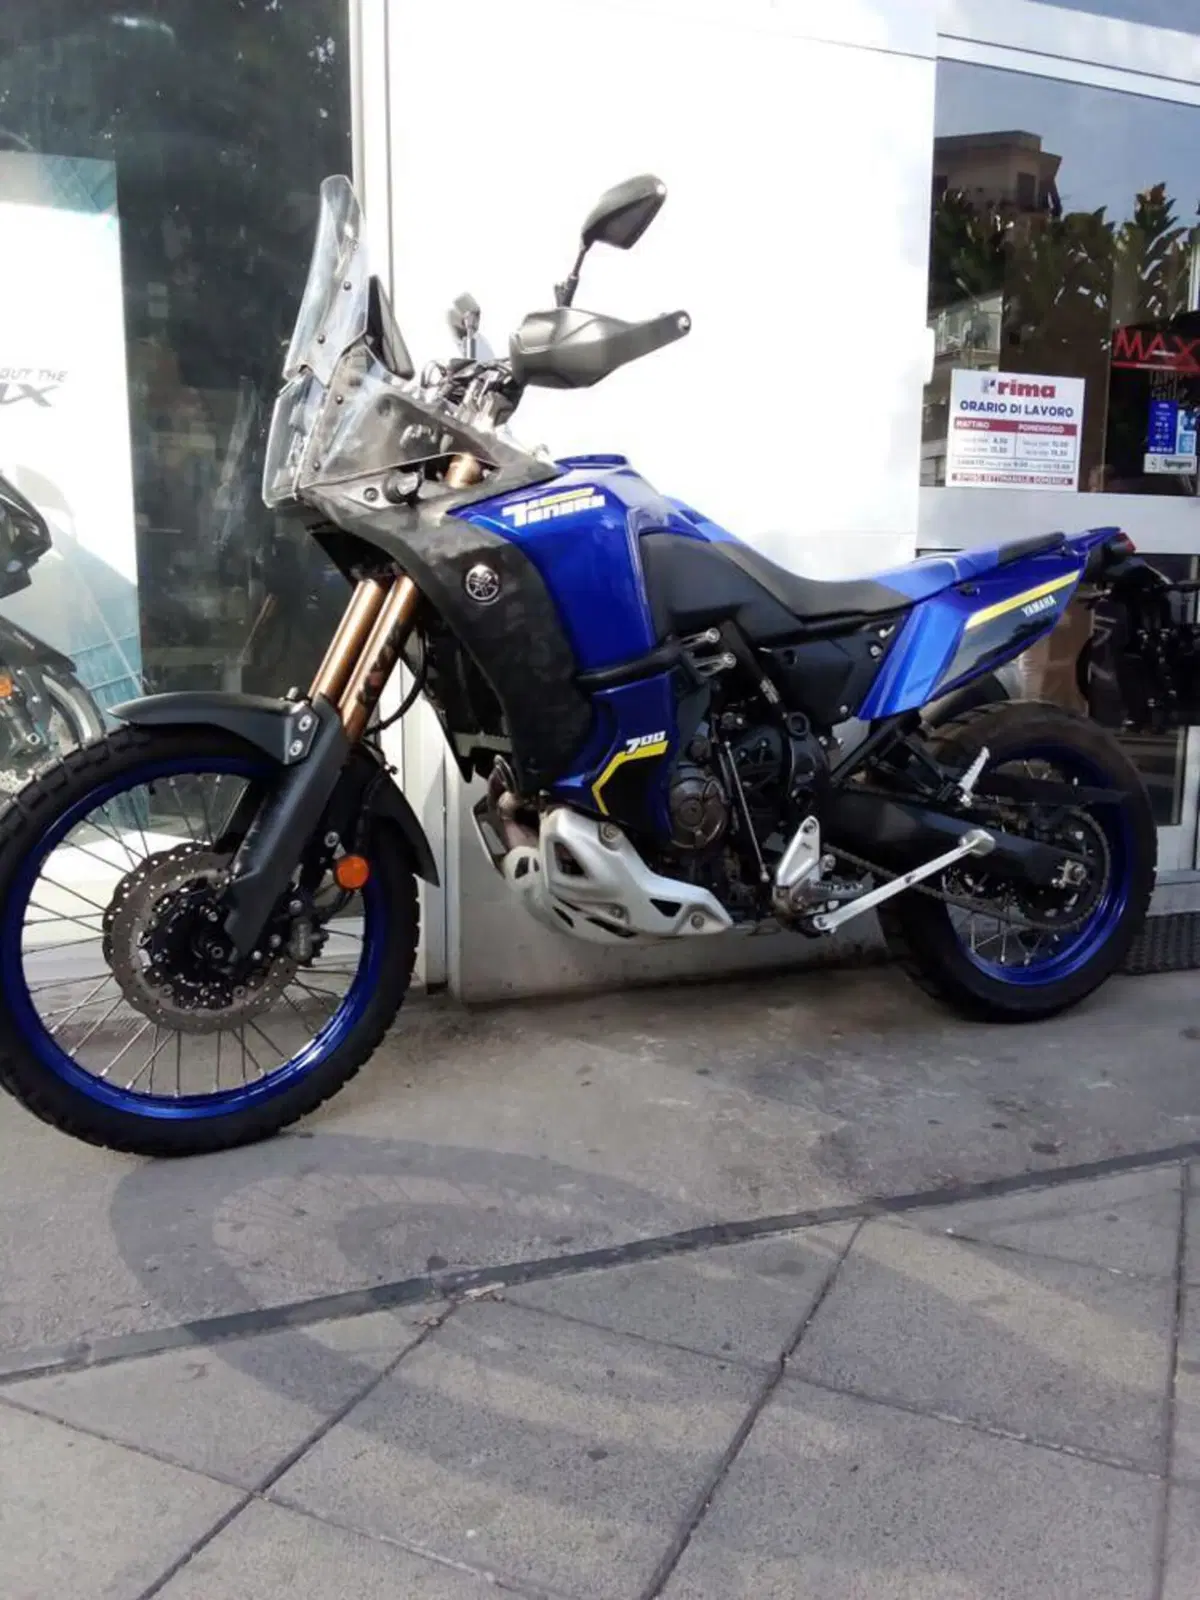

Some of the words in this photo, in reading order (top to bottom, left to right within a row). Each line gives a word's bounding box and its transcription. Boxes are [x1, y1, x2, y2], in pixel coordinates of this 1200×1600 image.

[38, 369, 69, 383] THE
[960, 400, 1007, 415] ORARIO
[1010, 403, 1022, 414] DI
[1025, 404, 1074, 418] LAVORO
[1020, 594, 1057, 617] YAMAHA
[625, 730, 666, 755] 700
